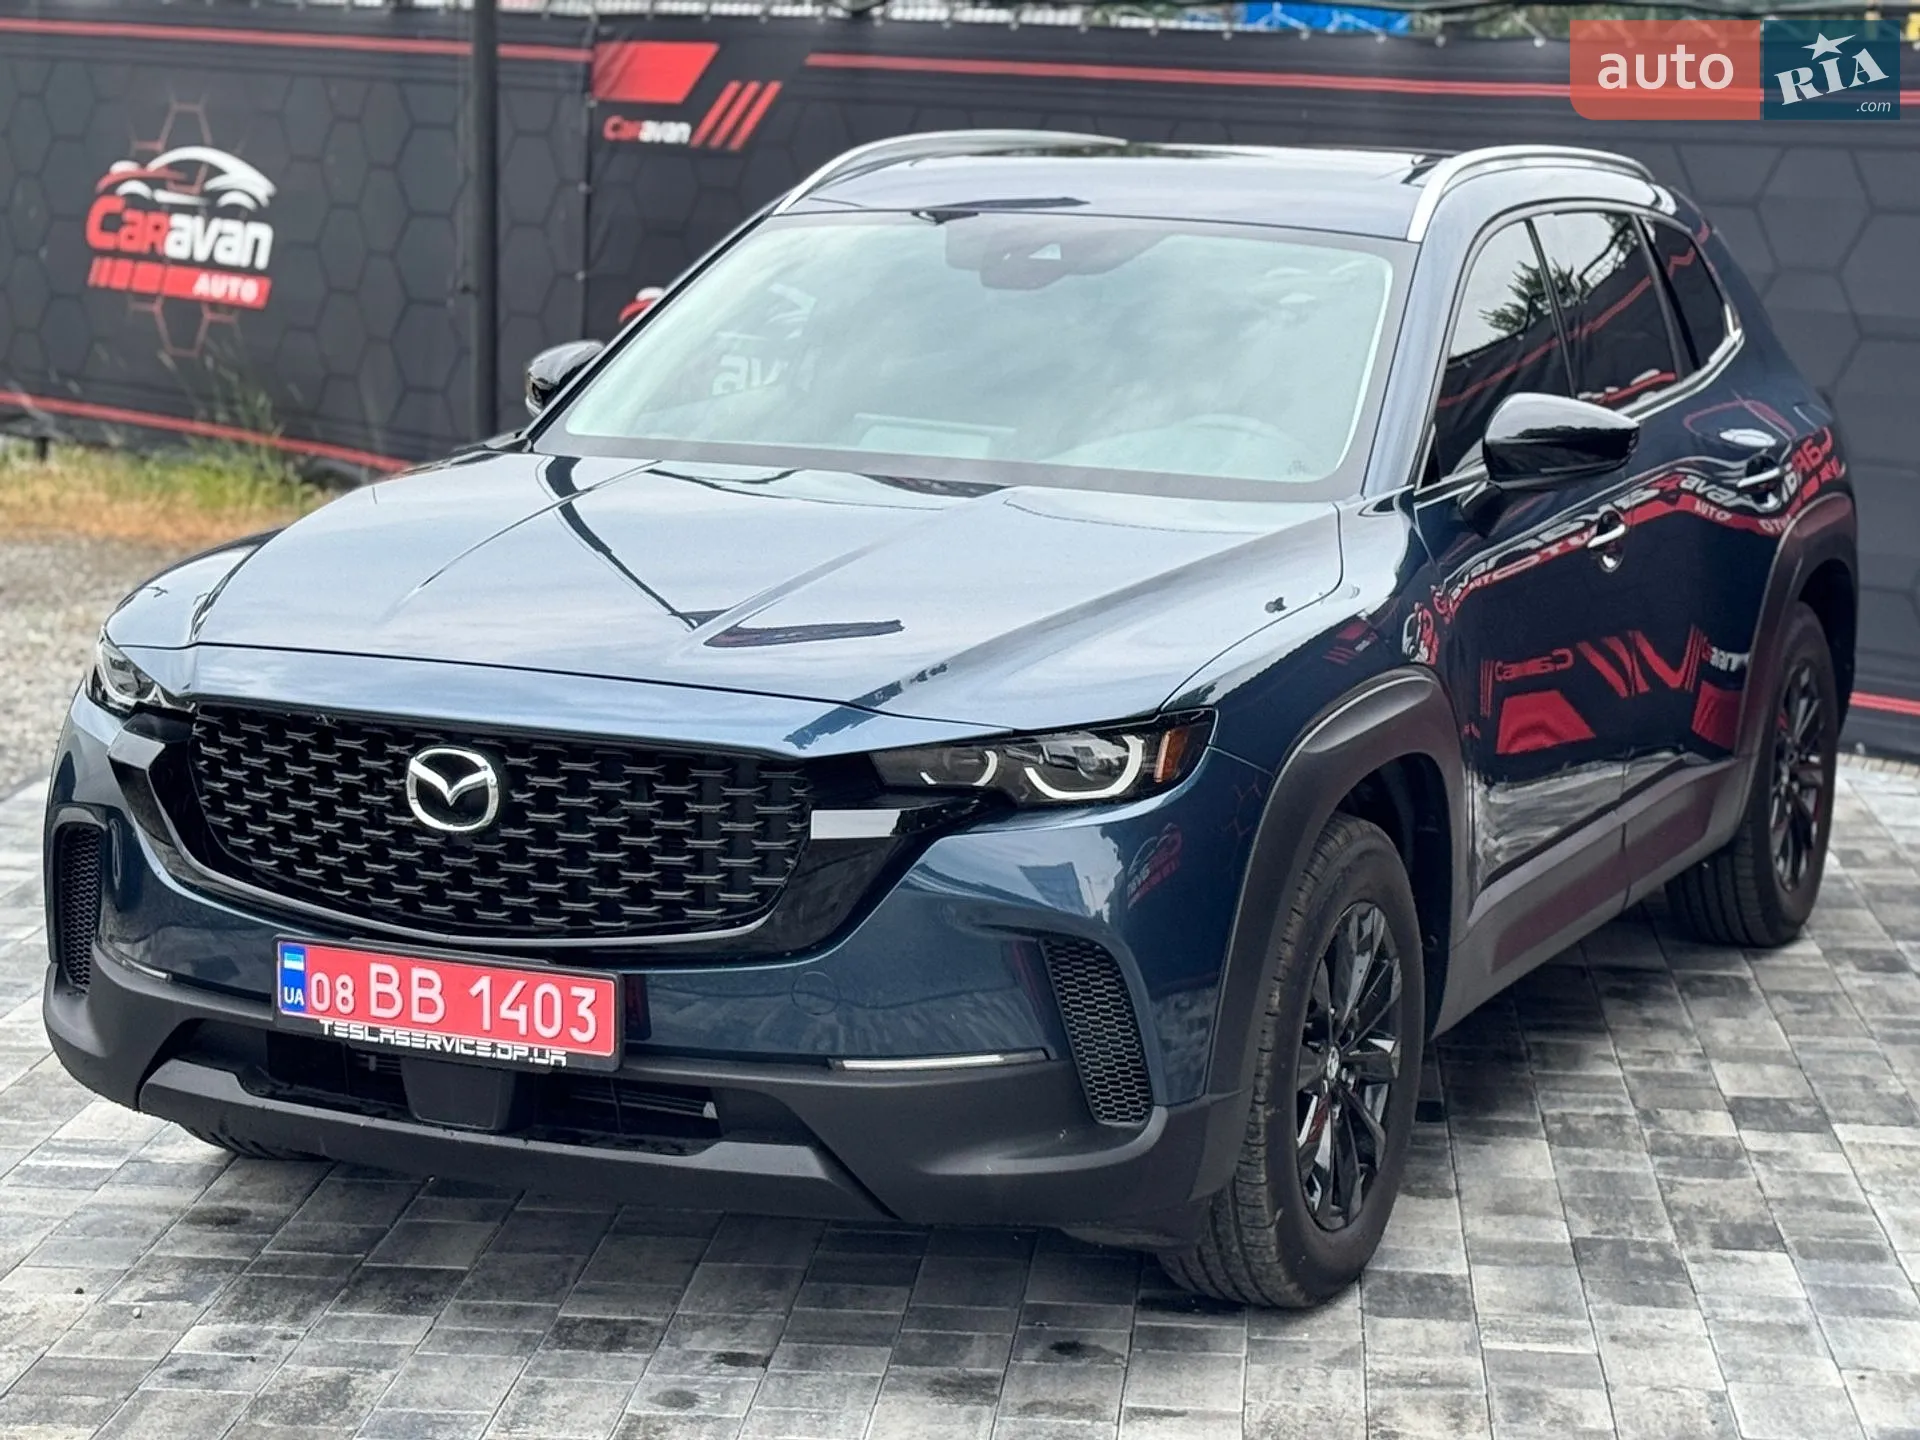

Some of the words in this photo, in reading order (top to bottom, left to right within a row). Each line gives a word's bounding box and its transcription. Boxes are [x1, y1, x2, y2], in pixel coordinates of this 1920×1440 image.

[192, 272, 260, 304] AUTO
[284, 987, 305, 1007] UA
[310, 971, 356, 1015] 08
[368, 962, 446, 1024] BB
[468, 974, 598, 1044] 1403
